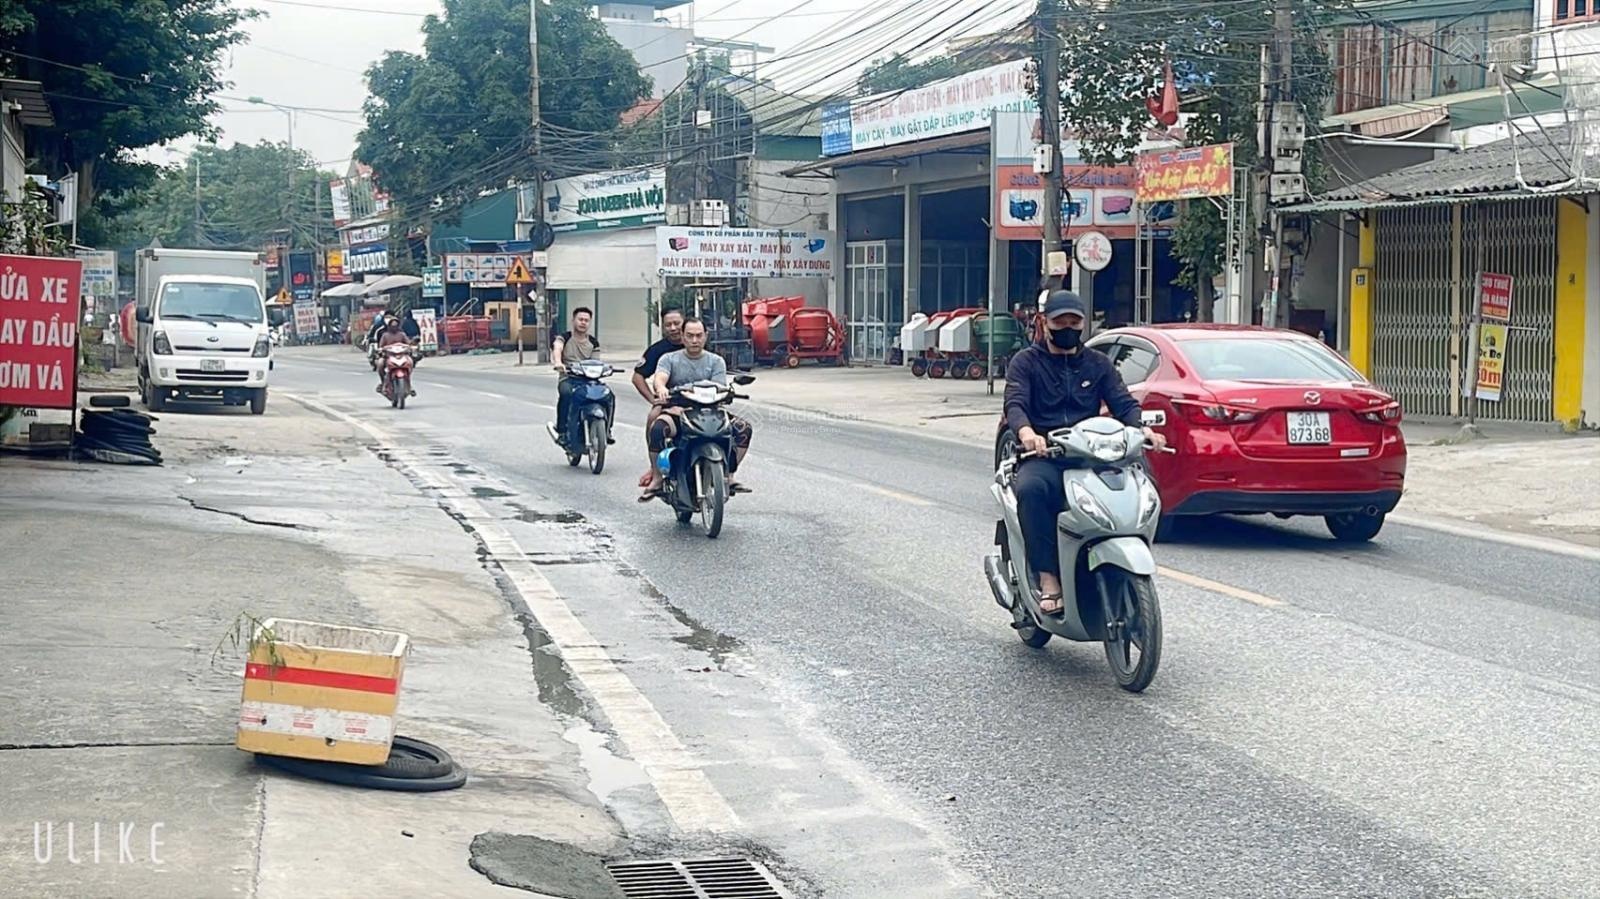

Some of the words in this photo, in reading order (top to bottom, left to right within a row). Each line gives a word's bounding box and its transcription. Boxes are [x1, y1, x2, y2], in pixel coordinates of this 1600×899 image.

[700, 241, 719, 253] MÁY
[760, 241, 779, 254] MÁY
[662, 256, 679, 267] MÁY
[682, 256, 702, 268] PHÁT
[732, 256, 749, 269] MÁY
[40, 276, 68, 303] XE
[32, 312, 75, 348] DẦU
[37, 360, 63, 391] VÁ
[1298, 412, 1320, 427] 30A
[1290, 427, 1330, 442] 873.68
